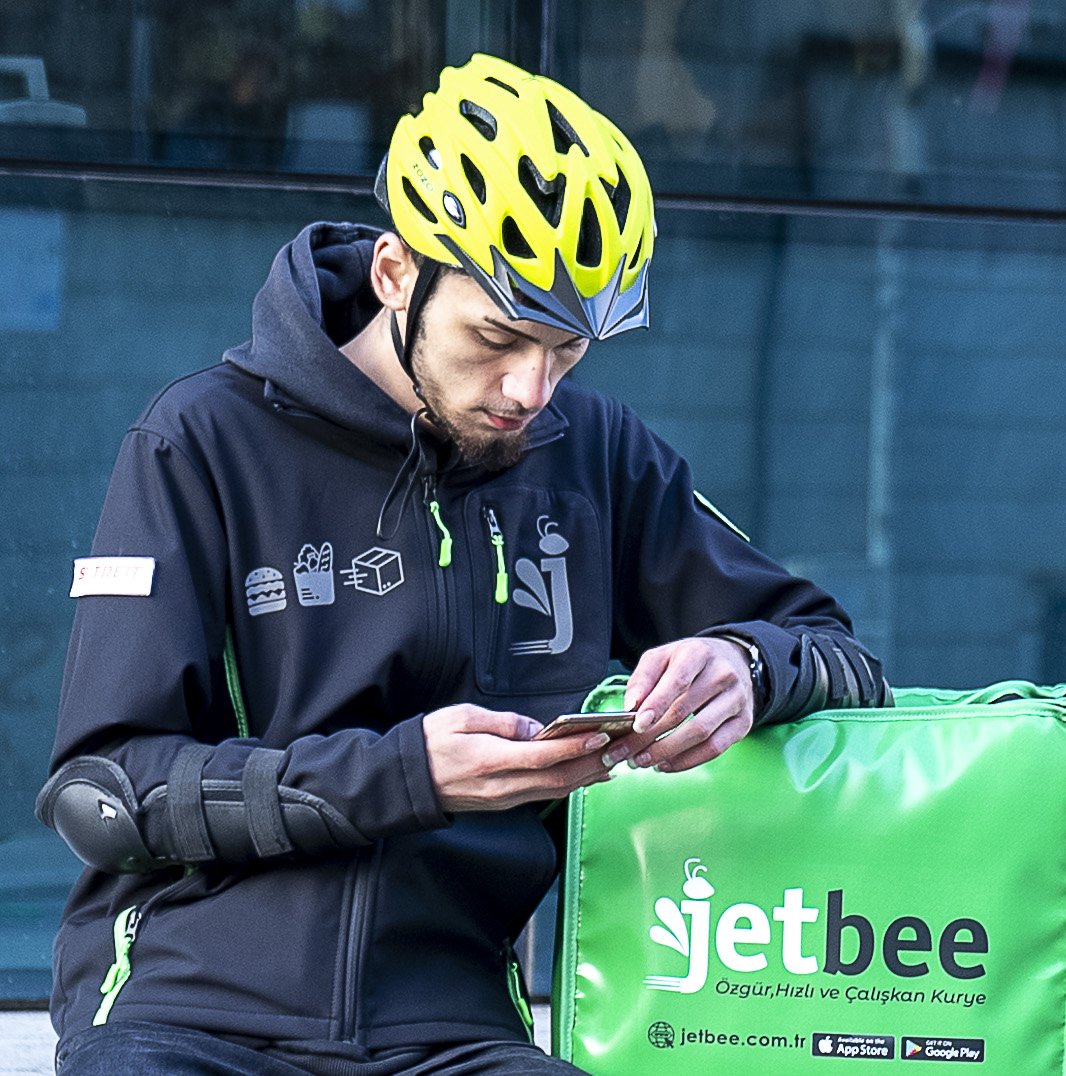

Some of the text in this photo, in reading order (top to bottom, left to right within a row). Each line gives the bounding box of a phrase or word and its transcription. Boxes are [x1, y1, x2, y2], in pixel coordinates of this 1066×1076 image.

[680, 876, 990, 994] jetbee
[819, 988, 840, 999] ve
[845, 986, 925, 1005] Çalışkan
[930, 989, 987, 1008] Kurye
[679, 1027, 806, 1048] jetbee.com.tr
[836, 1043, 889, 1057] App Store
[925, 1046, 980, 1060] Google Play
